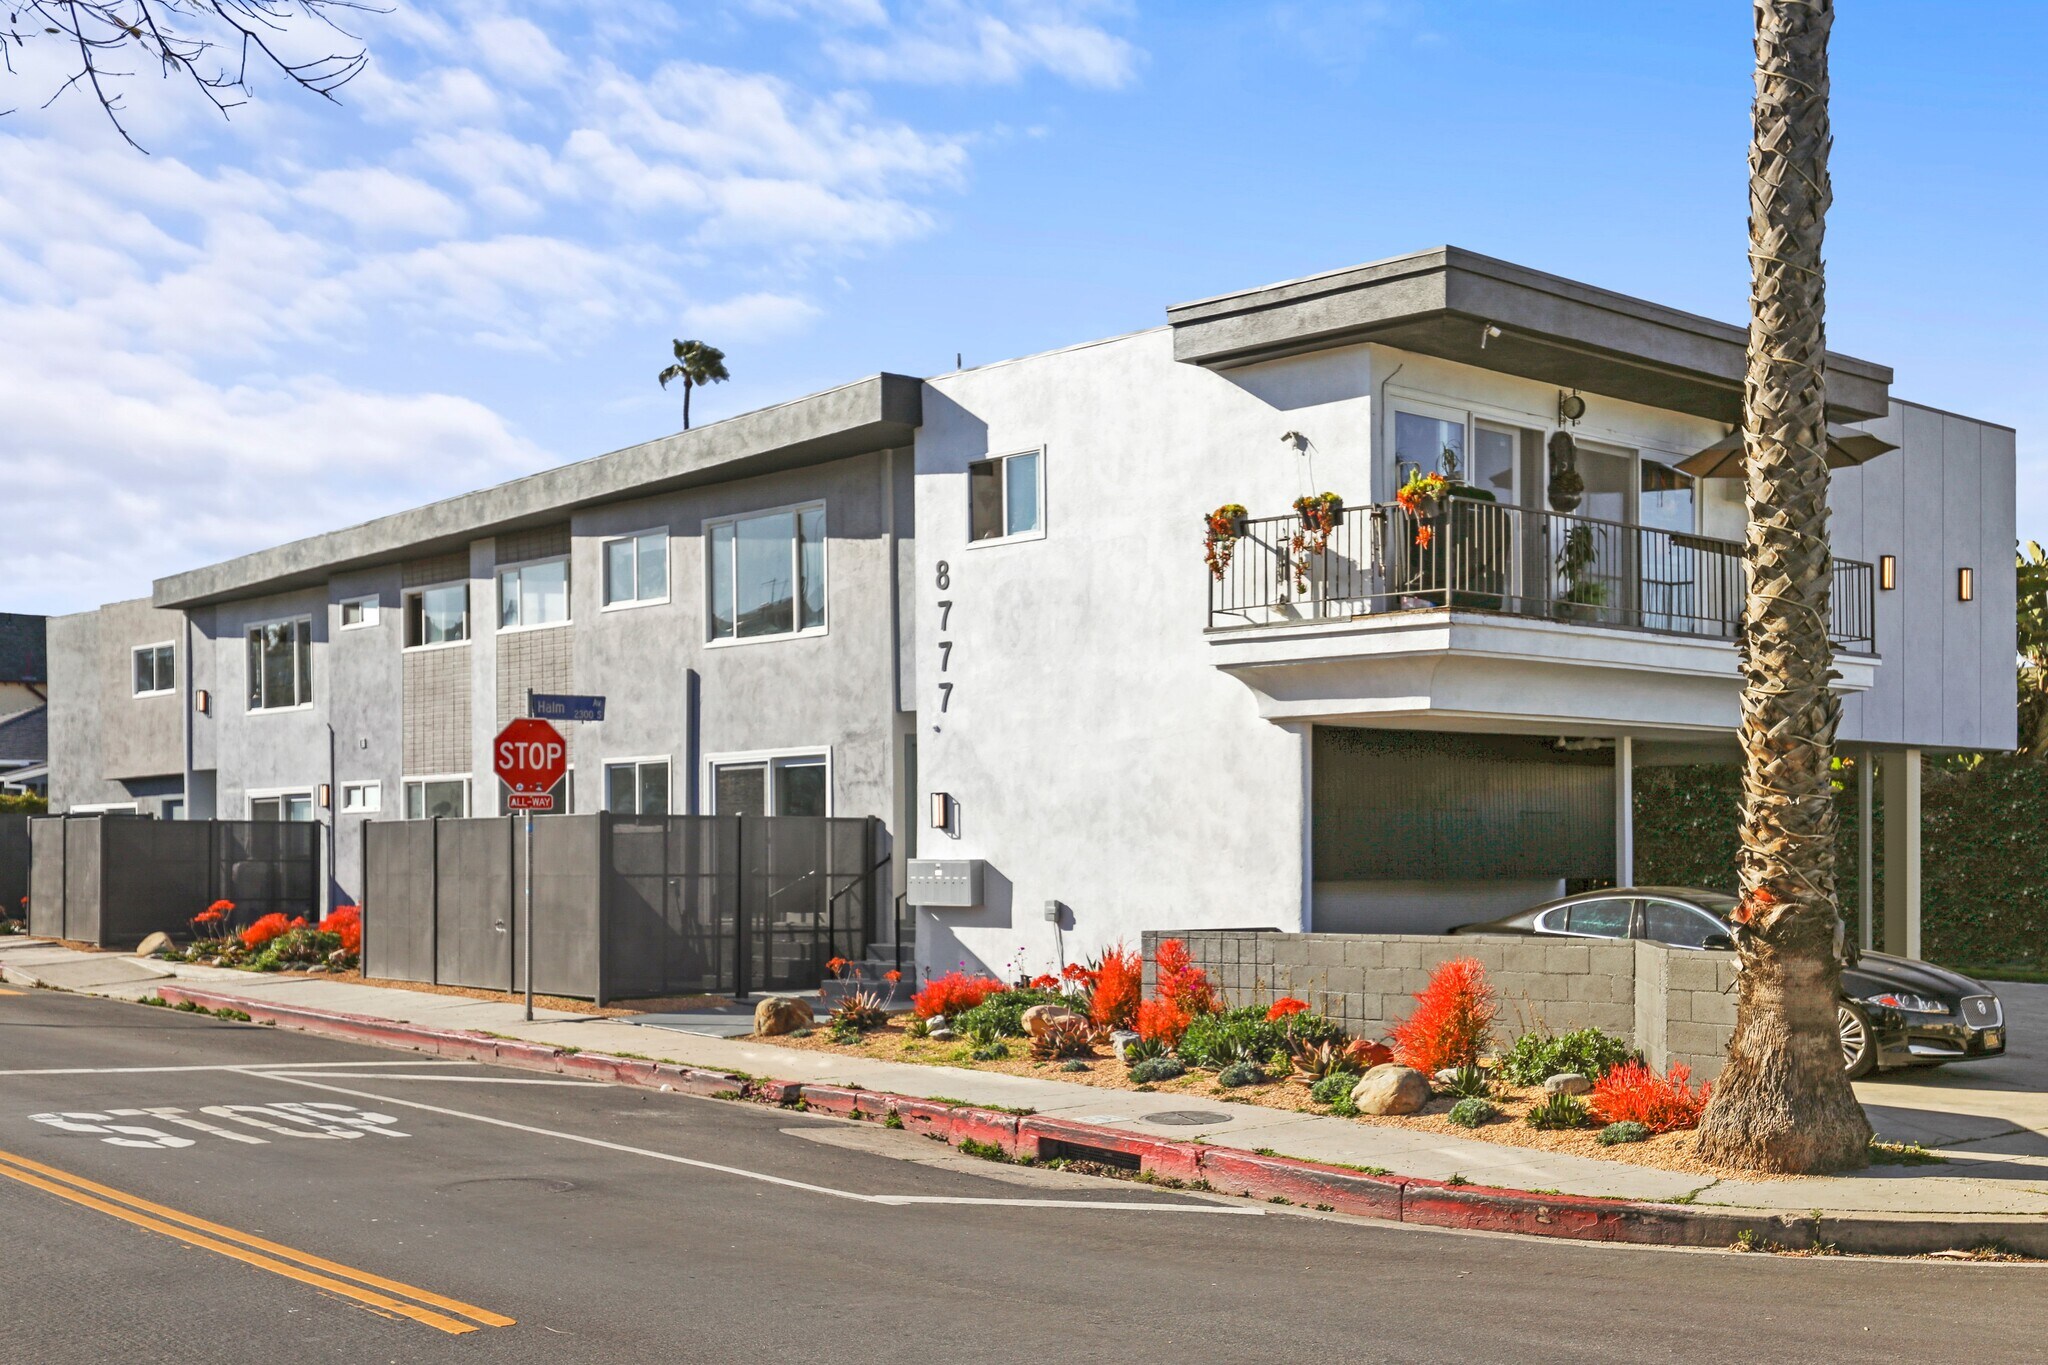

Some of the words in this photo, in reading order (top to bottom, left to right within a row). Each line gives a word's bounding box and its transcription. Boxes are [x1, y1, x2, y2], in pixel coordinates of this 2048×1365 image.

[935, 559, 954, 714] 8777
[537, 701, 565, 714] Halm
[498, 741, 562, 770] STOP
[510, 798, 551, 807] ALL-WAY
[27, 1102, 413, 1148] STOP
